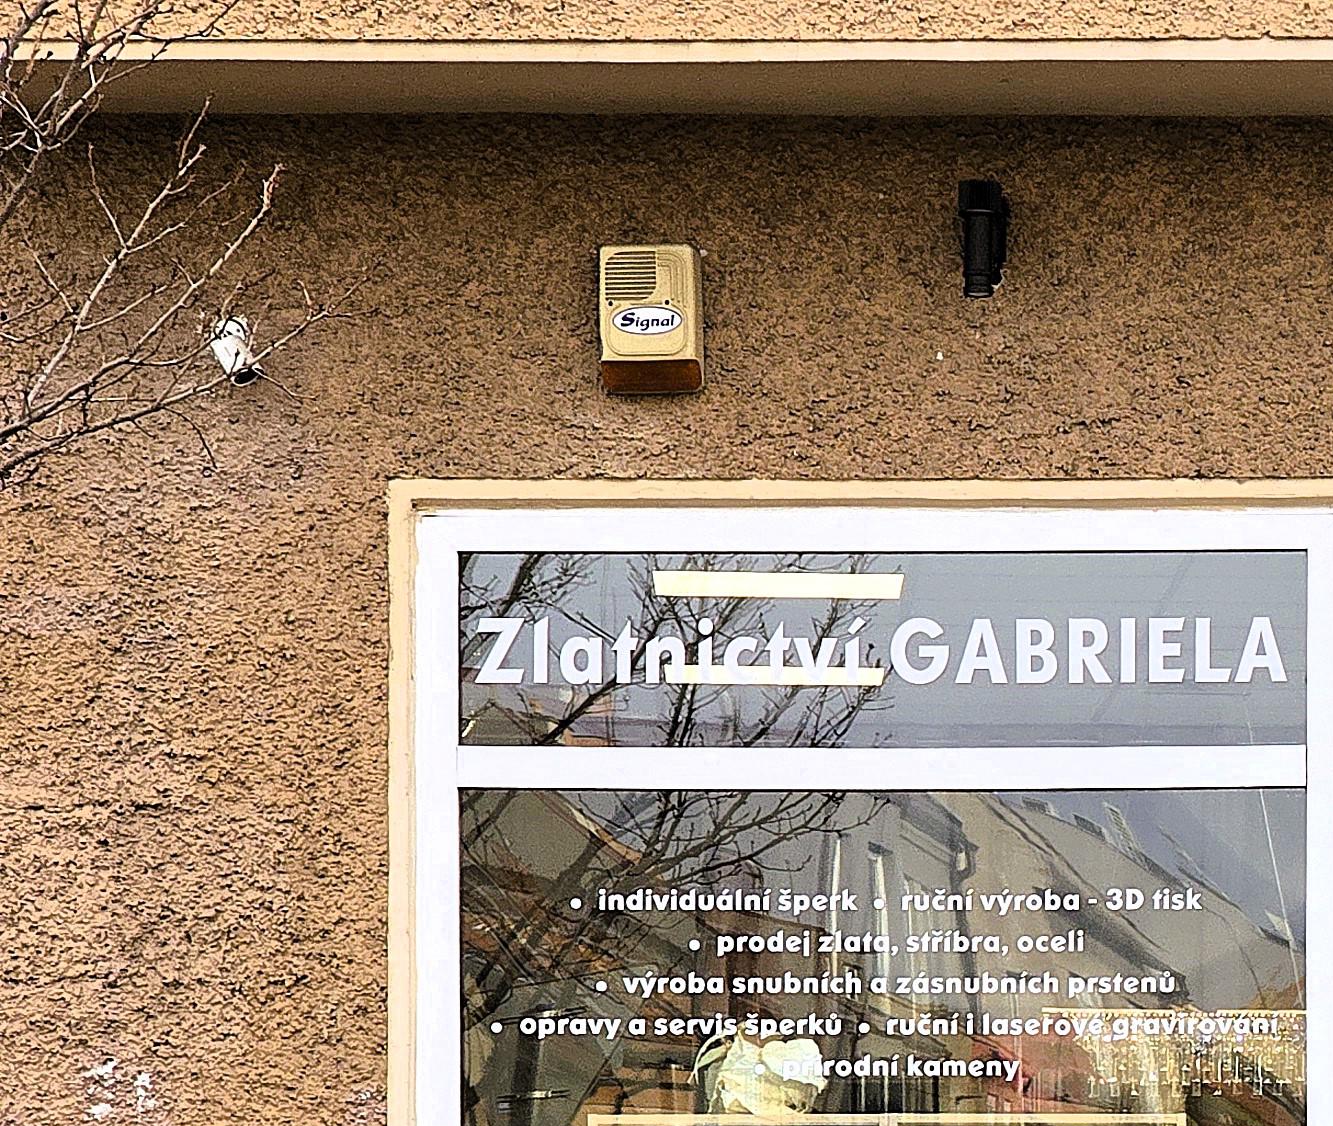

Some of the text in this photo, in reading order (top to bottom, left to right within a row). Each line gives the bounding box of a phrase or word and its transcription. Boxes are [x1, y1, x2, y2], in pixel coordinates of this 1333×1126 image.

[620, 312, 674, 331] Signal
[474, 616, 1288, 686] Zlatnictví GABRIELA
[598, 888, 858, 916] individuální šperk
[901, 888, 973, 911] ruční
[981, 888, 1081, 916] výroba
[1106, 889, 1144, 911] 3D
[1152, 888, 1203, 911] tisk
[716, 930, 1085, 957] prodej zlata, stříbra, oceli
[623, 970, 1175, 998] výroba snubních a zásnubních prstenů
[520, 1012, 842, 1039] opravy a servis šperků
[886, 1012, 959, 1036] ruční
[966, 1012, 974, 1035] i
[983, 1012, 1100, 1036] laserové
[907, 1057, 1020, 1081] kameny
